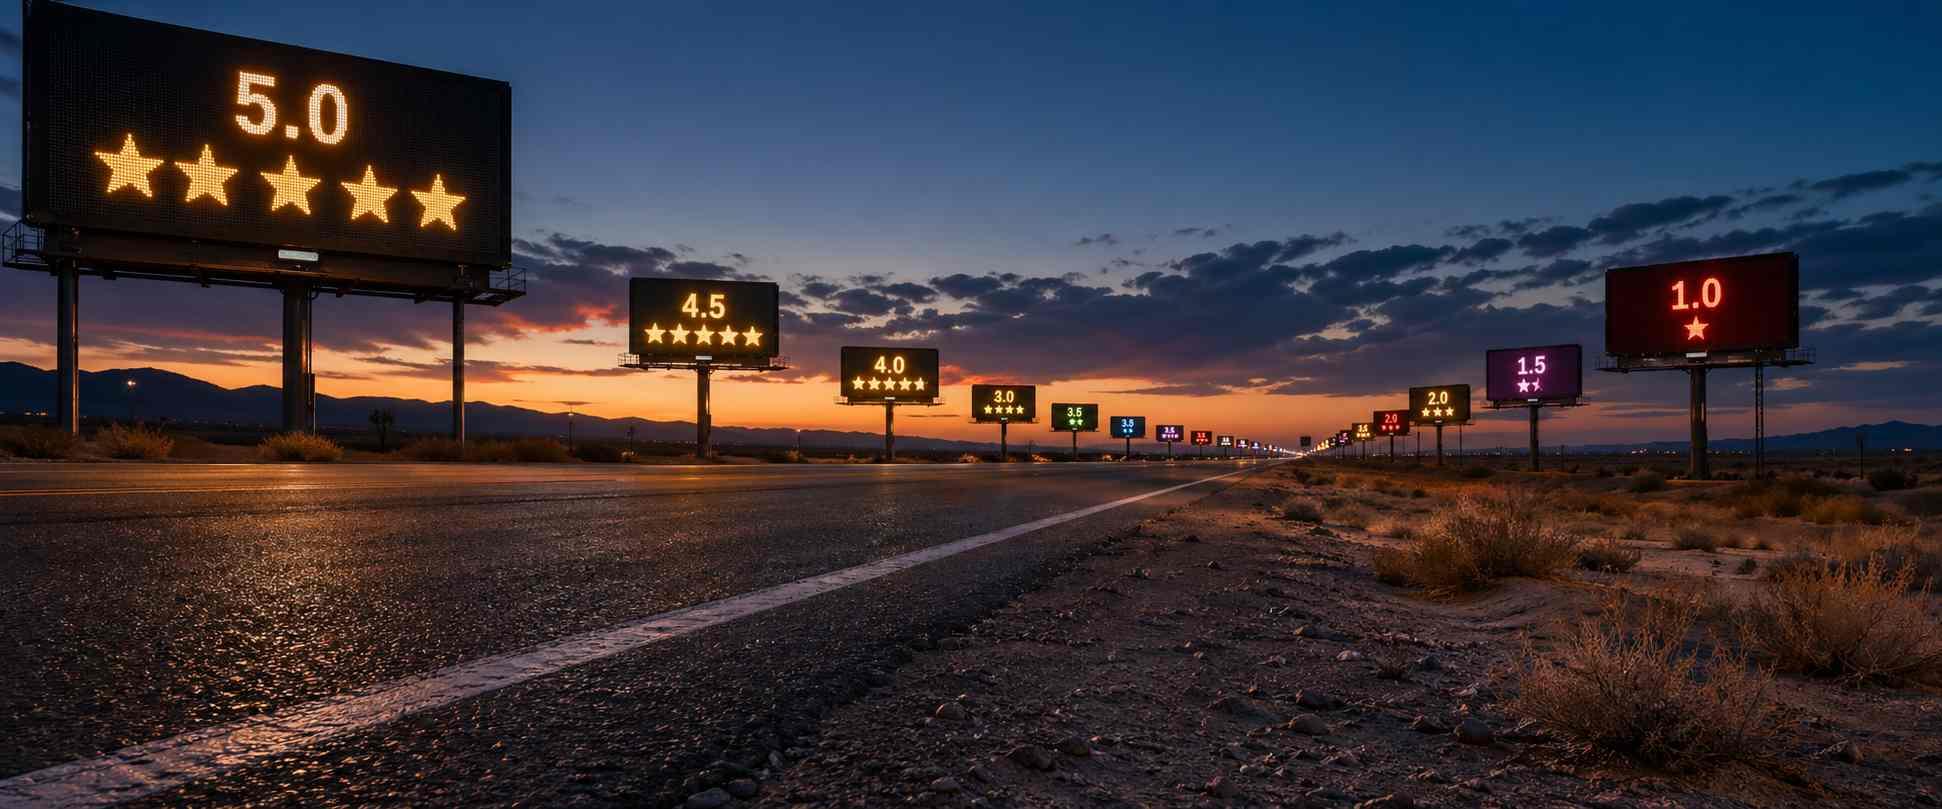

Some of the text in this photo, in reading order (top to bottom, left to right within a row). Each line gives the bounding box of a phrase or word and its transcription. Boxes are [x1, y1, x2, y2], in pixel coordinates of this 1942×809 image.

[234, 70, 350, 145] 5.0
[1671, 278, 1723, 311] 1.0
[682, 293, 726, 320] 4.5
[874, 356, 905, 374] 4.0
[1518, 356, 1546, 375] 1.5
[994, 390, 1015, 403] 3.0
[1428, 391, 1448, 405] 2.0
[1385, 414, 1398, 423] 2.0
